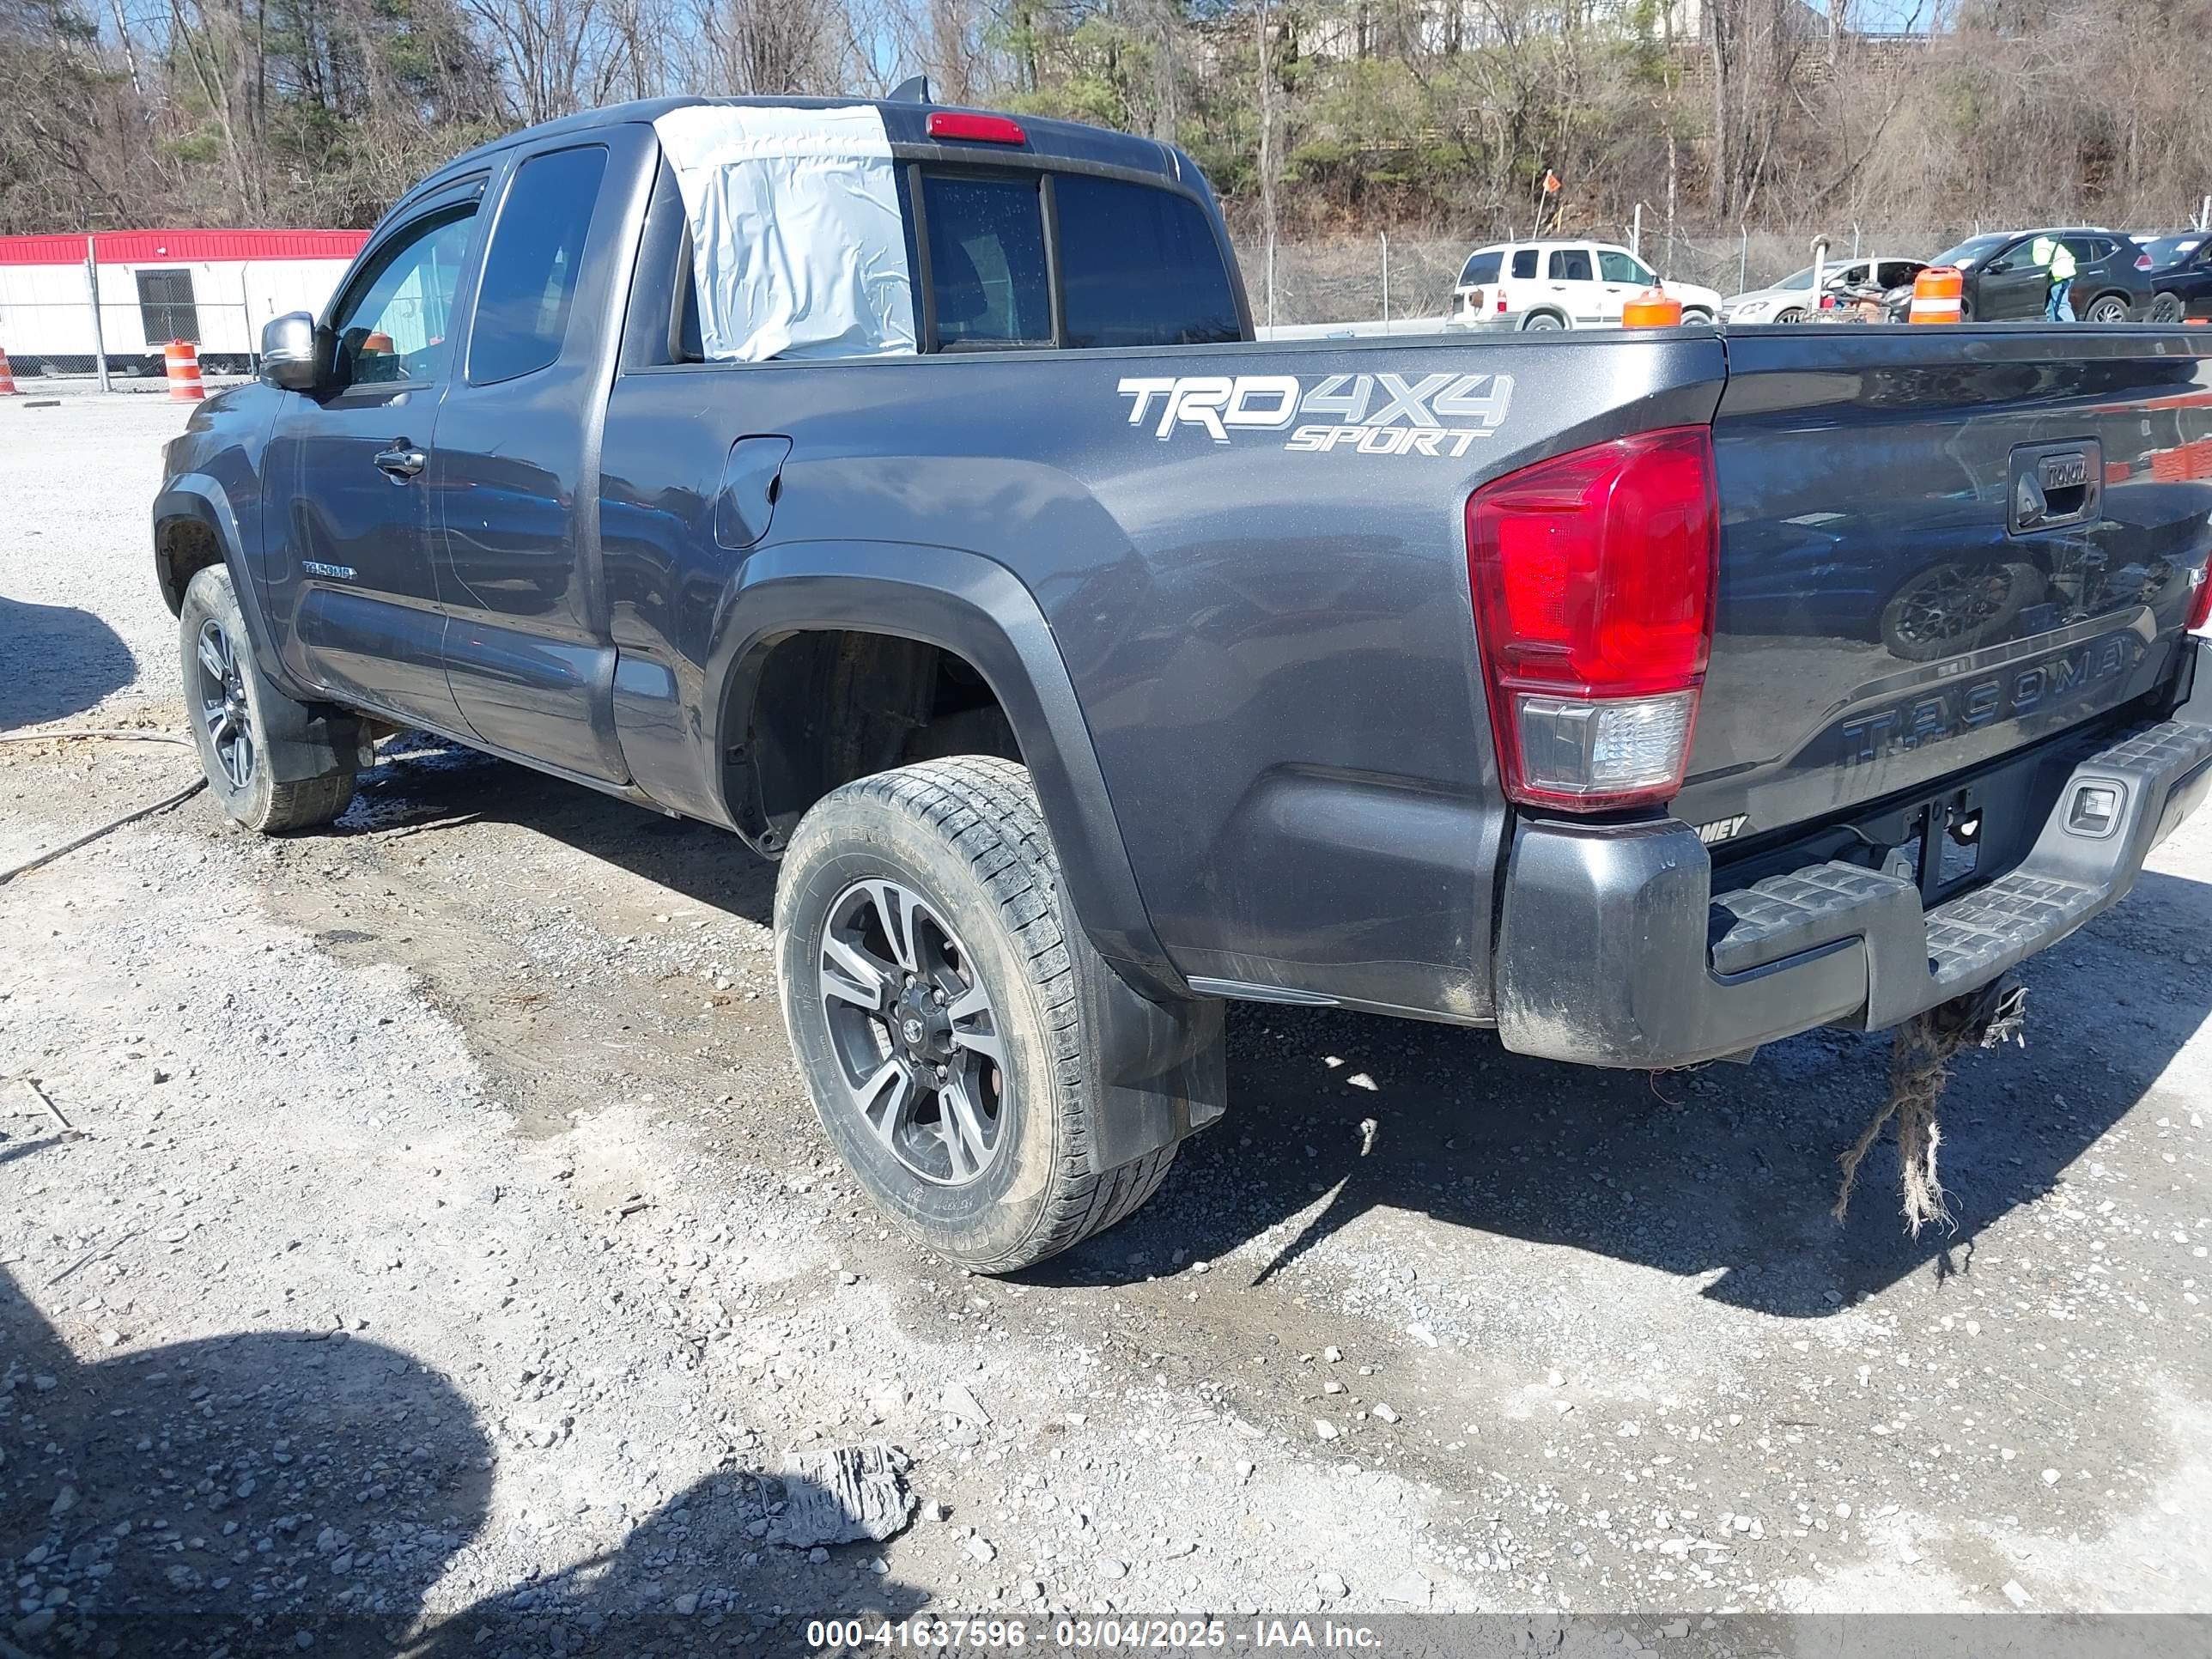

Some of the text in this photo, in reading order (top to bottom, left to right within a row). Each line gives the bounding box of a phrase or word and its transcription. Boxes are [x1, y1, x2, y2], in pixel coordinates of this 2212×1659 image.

[1116, 375, 1303, 445] TRD
[1285, 425, 1496, 458] SPORT
[302, 561, 357, 580] TACOMA
[1842, 639, 2125, 759] TACOMA
